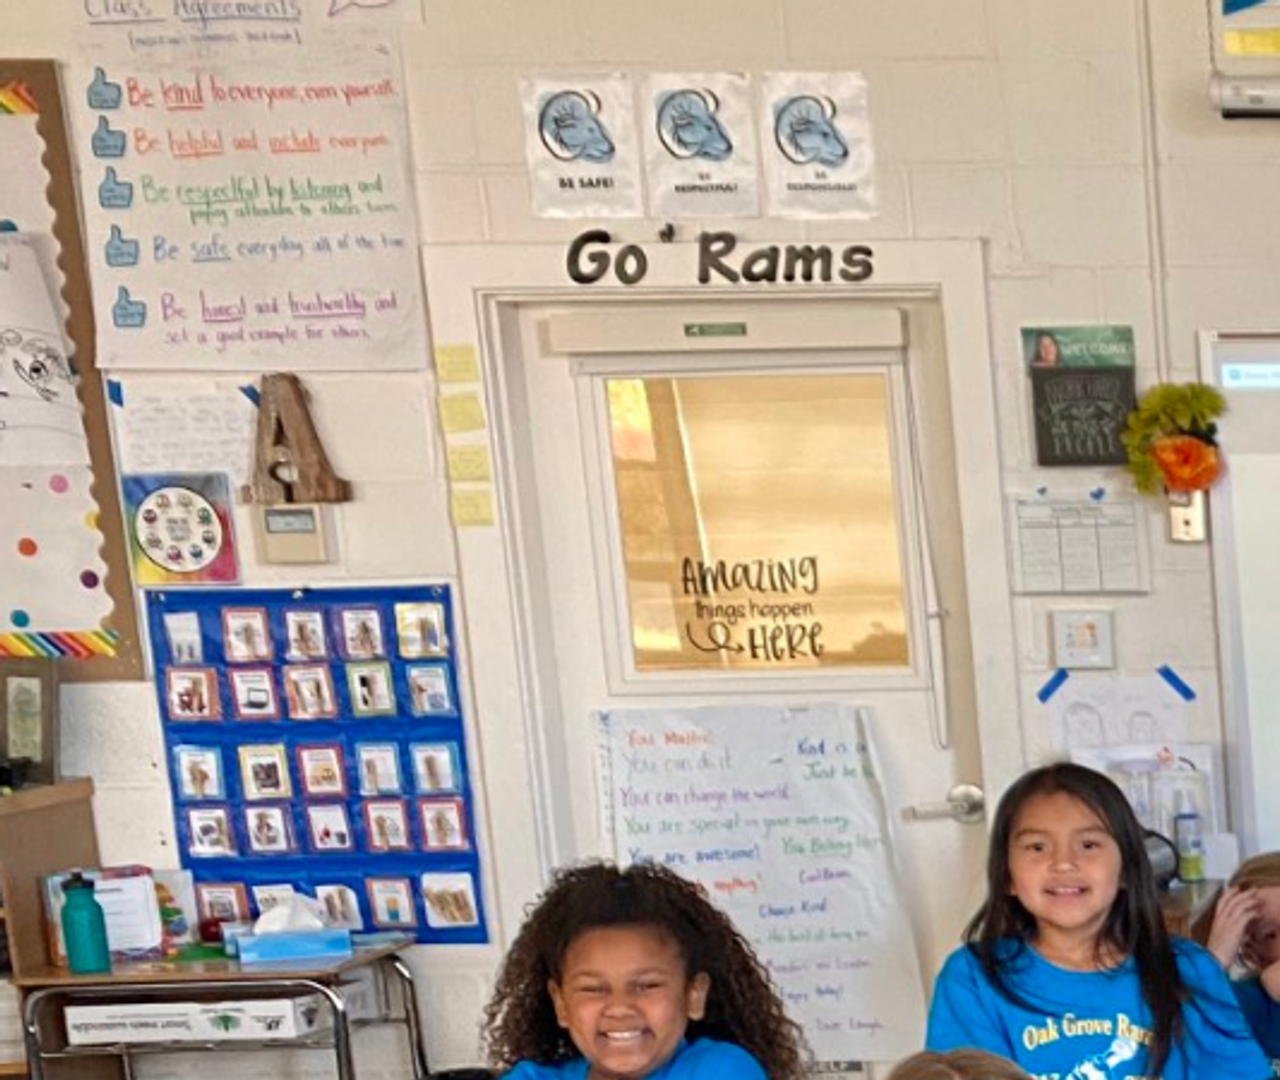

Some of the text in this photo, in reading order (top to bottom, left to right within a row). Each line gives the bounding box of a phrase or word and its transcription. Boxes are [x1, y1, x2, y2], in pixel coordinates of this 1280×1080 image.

[126, 77, 154, 106] Be
[160, 74, 203, 104] kind
[134, 127, 160, 154] Be
[142, 174, 169, 201] Be
[263, 175, 285, 202] by
[153, 236, 179, 261] Be
[191, 234, 230, 256] safe
[566, 229, 874, 286] Go Rams
[161, 293, 186, 321] Be
[749, 597, 815, 622] happen
[1022, 1016, 1060, 1051] Oak
[1062, 1012, 1113, 1038] Grove
